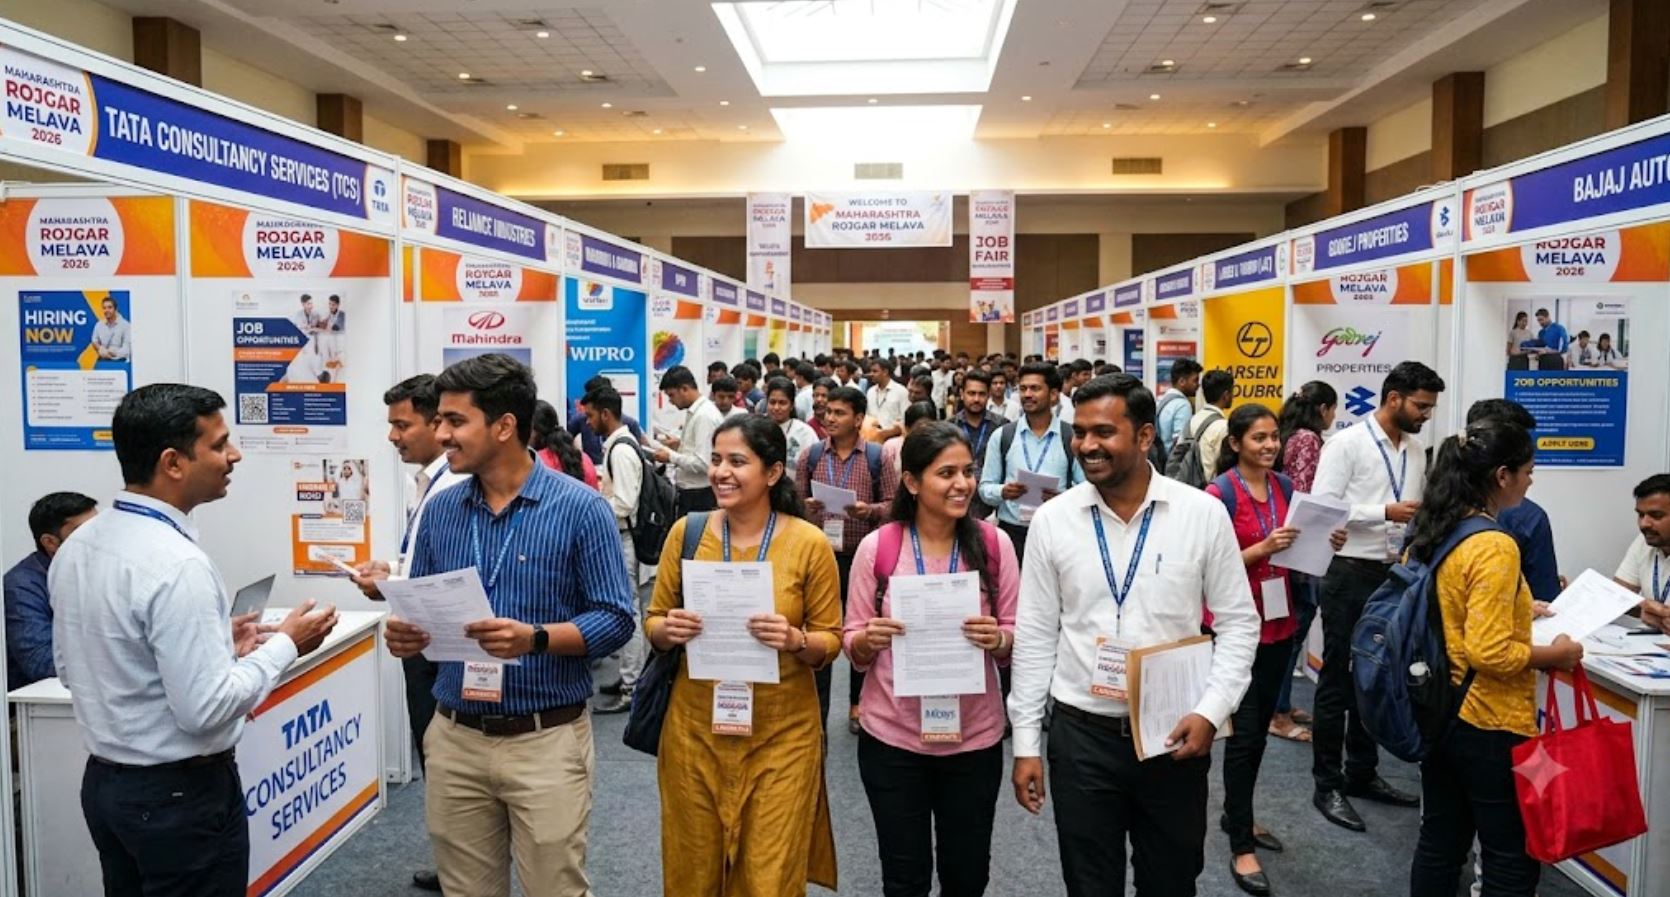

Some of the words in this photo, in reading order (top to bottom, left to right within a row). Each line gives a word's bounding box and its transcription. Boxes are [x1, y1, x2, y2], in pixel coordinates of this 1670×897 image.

[5, 79, 81, 115] ROJGAR
[6, 101, 82, 135] MELAVA
[31, 128, 62, 145] 2026
[104, 105, 153, 147] TATA
[156, 121, 267, 177] CONSULTANCY
[270, 151, 330, 193] SERVICES
[331, 171, 361, 206] (TCS)
[1573, 165, 1625, 203] BAJAJ
[848, 198, 893, 206] WELCOME
[896, 198, 907, 206] TO
[835, 210, 921, 219] MAHARASHTRA
[832, 221, 876, 230] ROJGAR
[879, 221, 925, 230] MELAVA
[40, 228, 109, 241] ROJGAR
[976, 236, 1009, 248] JOB
[41, 244, 110, 256] MELAVA
[257, 246, 325, 259] MELAVA
[975, 250, 1009, 262] FAIR
[62, 259, 90, 269] 2026
[1536, 252, 1606, 265] MELAVA
[277, 261, 305, 271] 2026
[1556, 267, 1585, 276] 2026
[465, 280, 512, 289] MELAVA
[1340, 284, 1388, 293] MELAVA
[24, 309, 87, 326] HIRING
[236, 322, 264, 335] JOB
[25, 327, 74, 344] NOW
[452, 333, 522, 345] Mahindra
[570, 346, 634, 361] WIPRO
[1317, 363, 1391, 373] PROPERTIES
[1536, 378, 1619, 388] OPPORTUNITIES
[281, 698, 332, 750] TATA
[245, 713, 361, 817] CONSULTANCY
[272, 762, 347, 840] SERVICES
